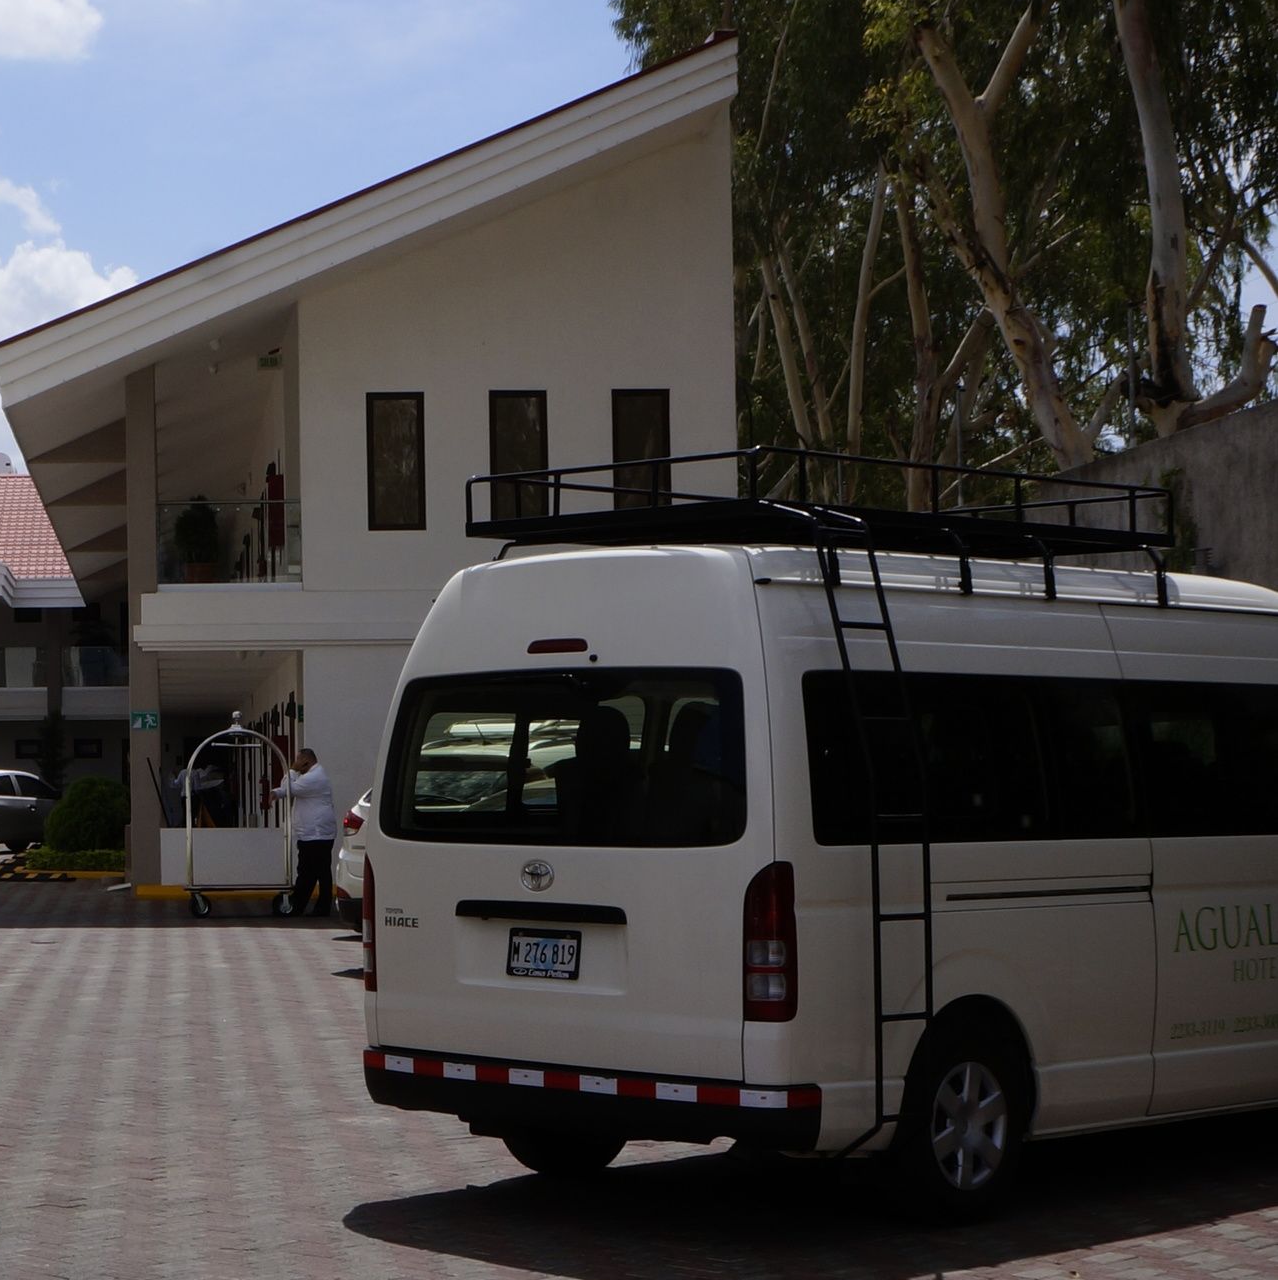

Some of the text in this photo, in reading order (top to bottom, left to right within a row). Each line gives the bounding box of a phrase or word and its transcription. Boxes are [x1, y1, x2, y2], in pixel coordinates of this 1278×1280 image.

[385, 916, 419, 928] HIACE
[1173, 904, 1278, 953] AGUAL
[512, 942, 575, 965] M 276 819
